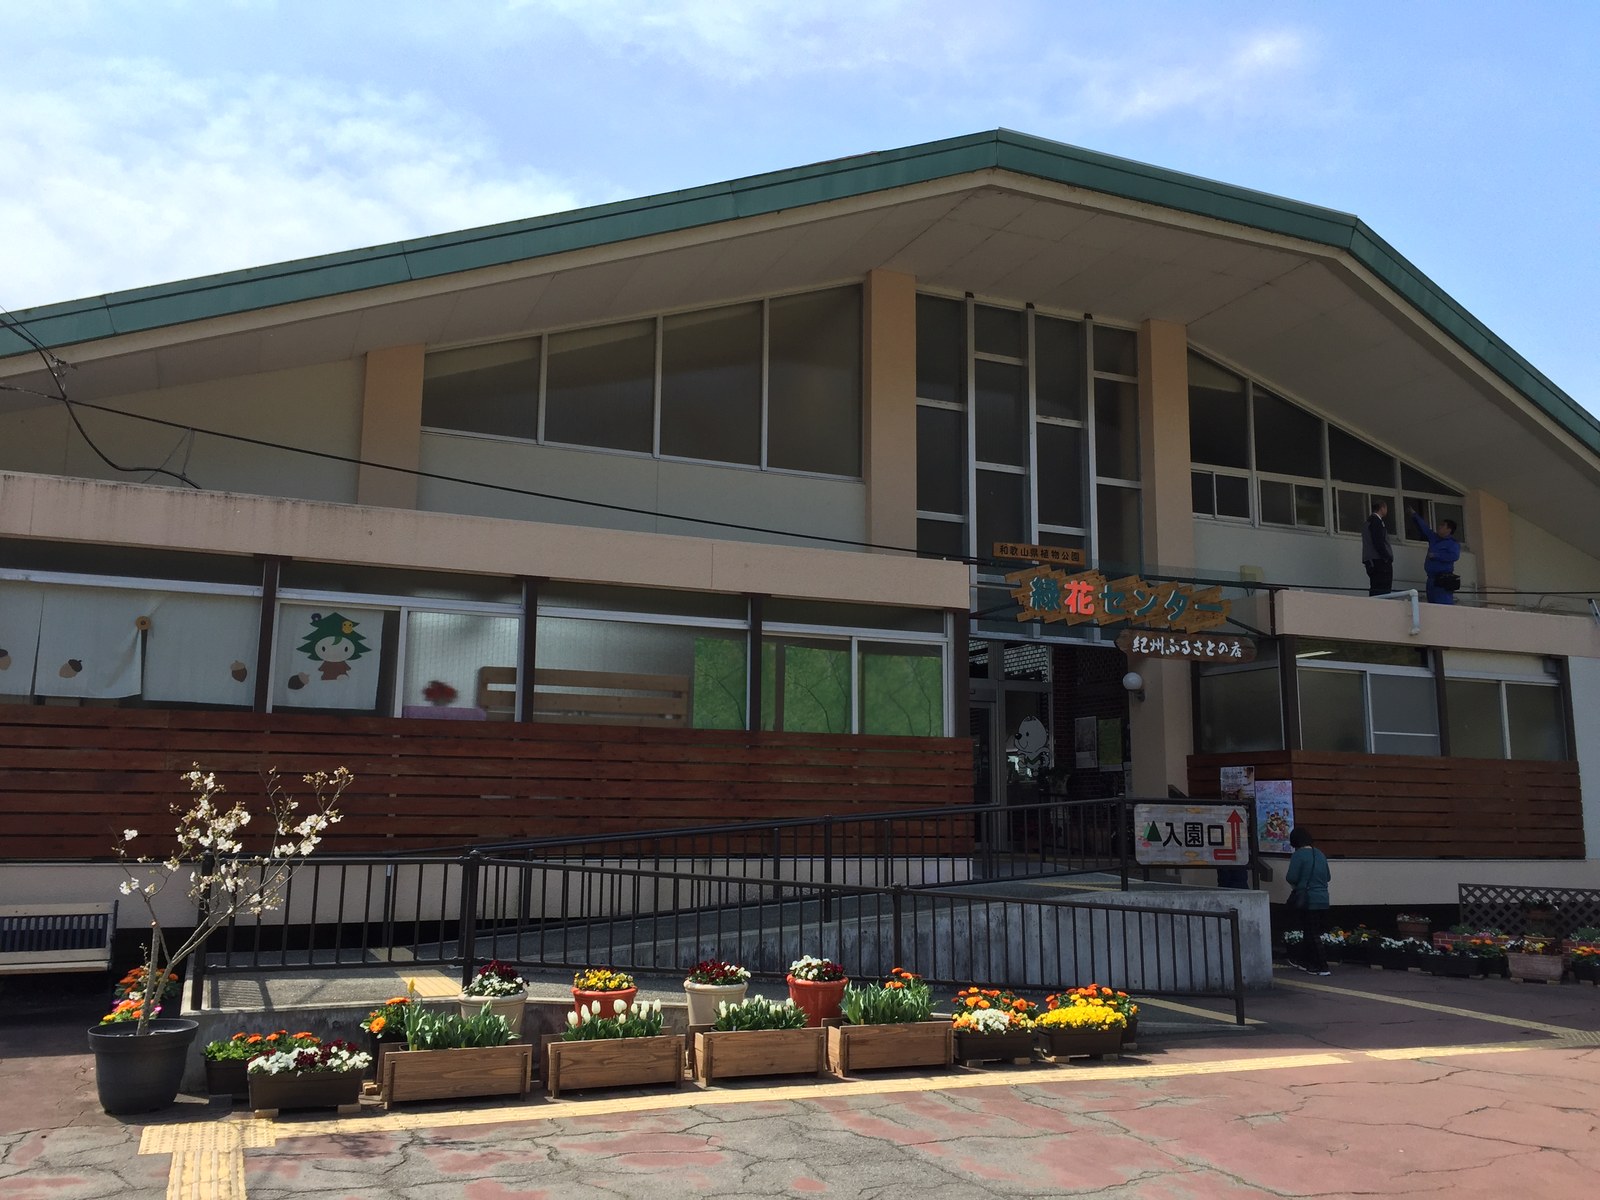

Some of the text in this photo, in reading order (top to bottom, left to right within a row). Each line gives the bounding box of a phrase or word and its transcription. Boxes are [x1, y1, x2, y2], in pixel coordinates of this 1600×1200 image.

[1000, 544, 1079, 561] 和歌山県植物公園
[1029, 576, 1223, 621] 緑花センター
[1132, 635, 1242, 658] 紀州ふるさとの店
[1162, 822, 1225, 847] 入園口
